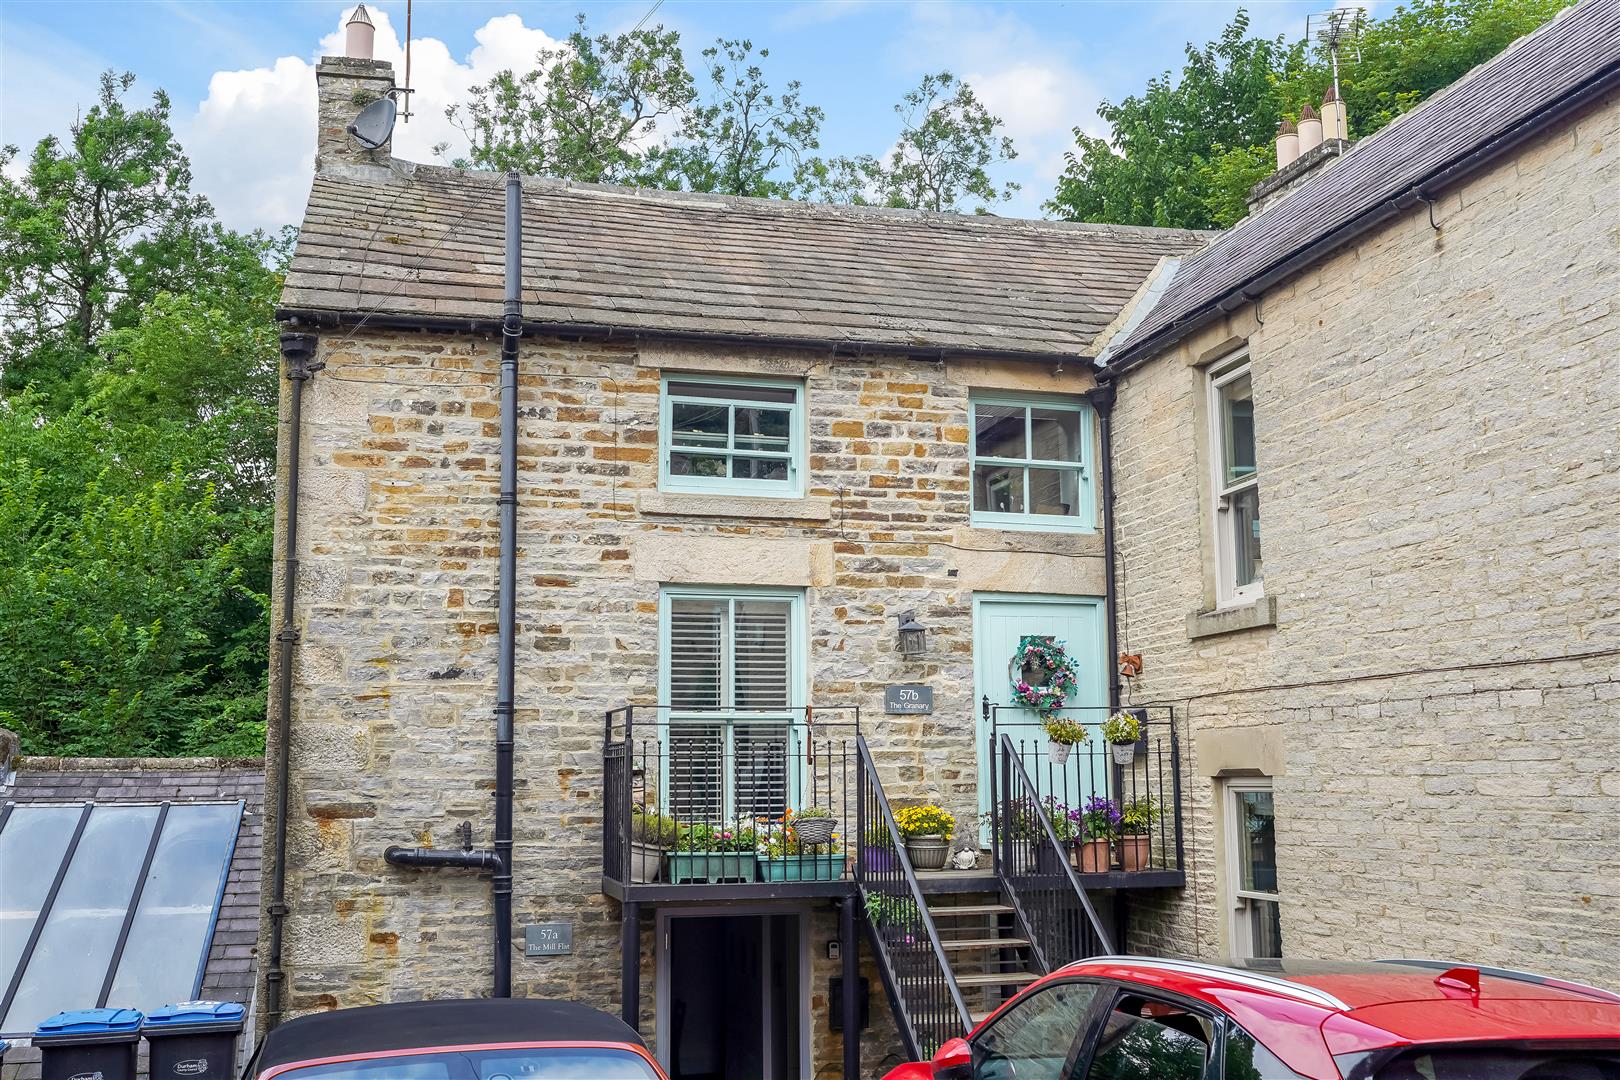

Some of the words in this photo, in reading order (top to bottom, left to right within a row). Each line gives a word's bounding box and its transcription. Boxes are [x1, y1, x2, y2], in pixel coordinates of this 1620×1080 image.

[900, 689, 919, 700] 57b
[903, 702, 929, 710] Granary
[540, 929, 559, 940] 57a
[528, 943, 541, 951] The
